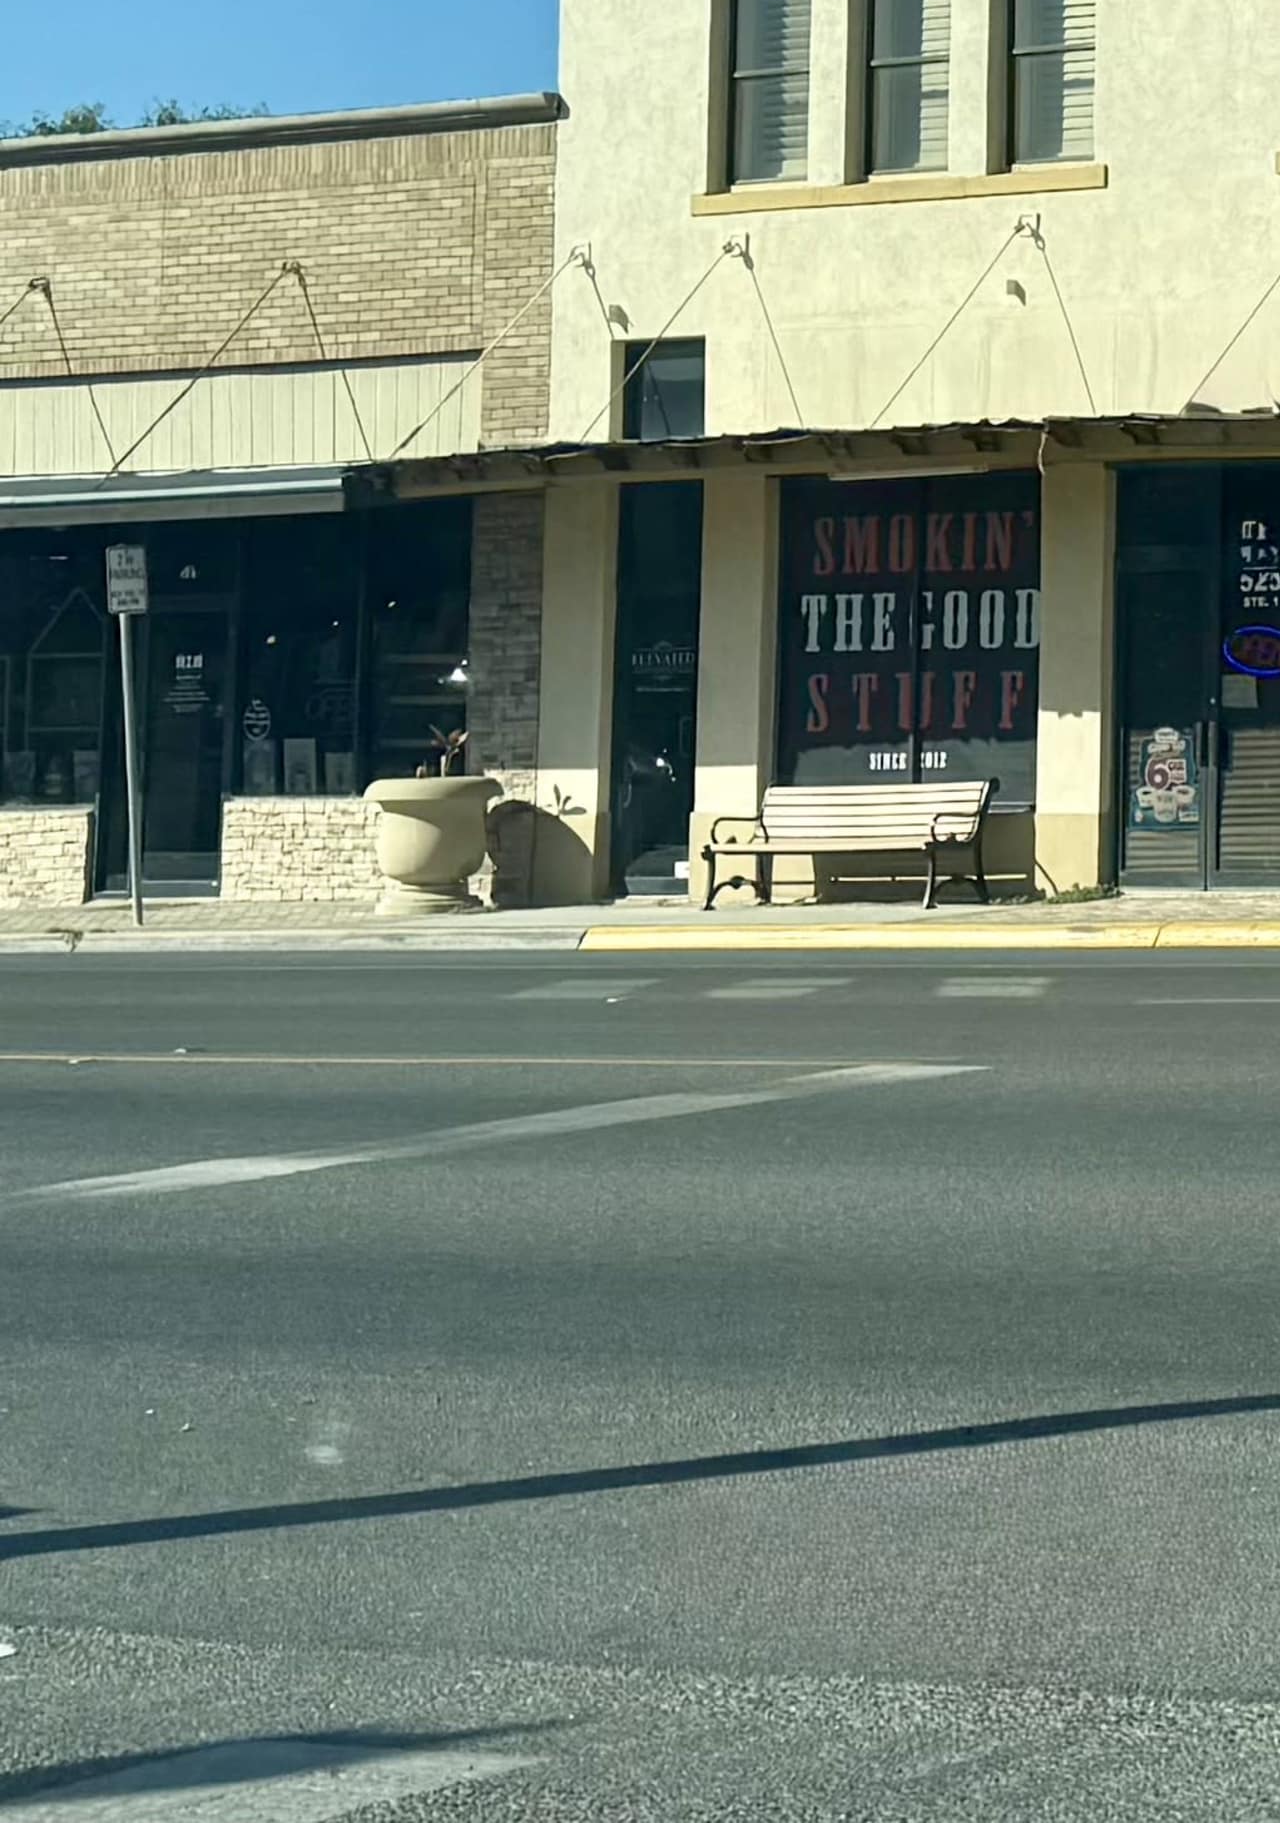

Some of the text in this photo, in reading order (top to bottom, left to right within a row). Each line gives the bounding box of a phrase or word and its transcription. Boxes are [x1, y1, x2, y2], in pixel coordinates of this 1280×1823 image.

[813, 511, 1034, 575] SMOKIN'
[801, 592, 896, 653] THE
[807, 671, 1024, 733] STUFF
